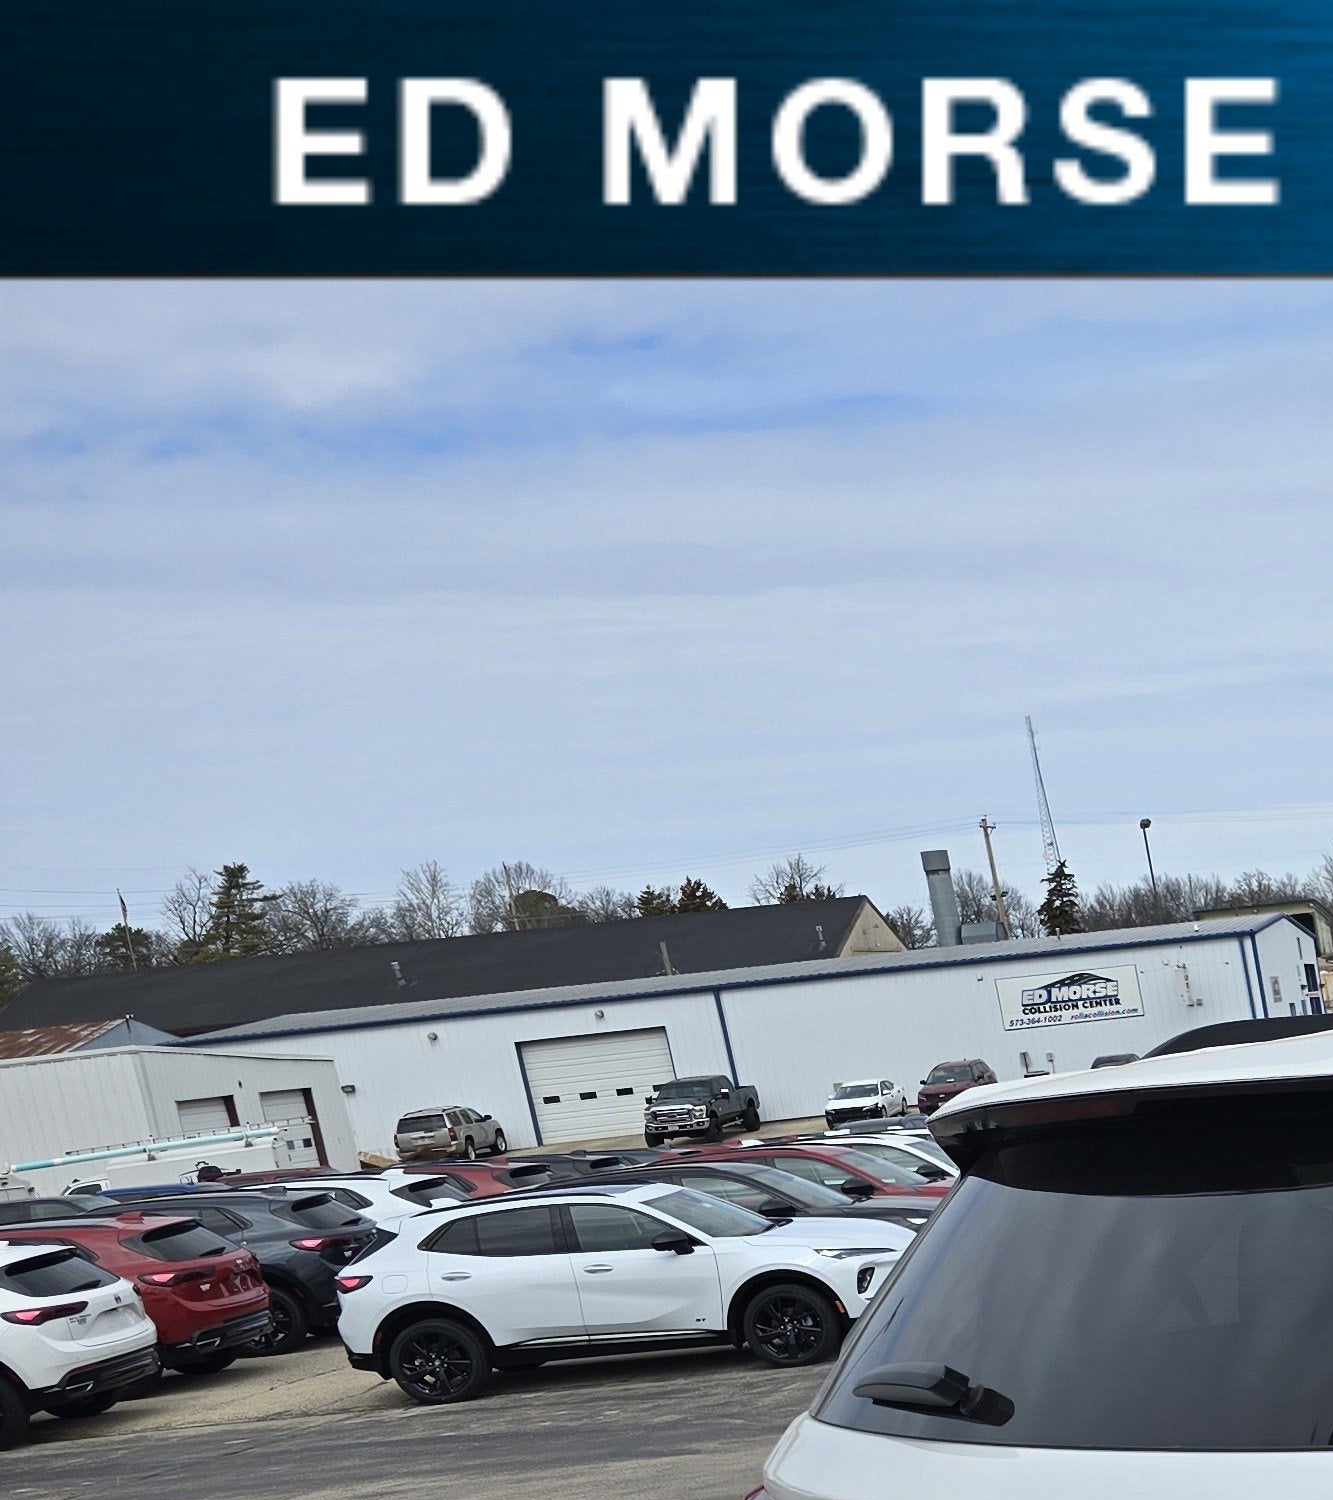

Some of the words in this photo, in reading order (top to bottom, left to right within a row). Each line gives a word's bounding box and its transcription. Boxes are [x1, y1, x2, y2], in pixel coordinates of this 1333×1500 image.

[1023, 990, 1048, 1005] ED
[1050, 981, 1119, 1002] MORSE
[1022, 1002, 1080, 1015] COLLISION
[1081, 998, 1122, 1010] CENTER
[1009, 1015, 1063, 1027] 573-364-1002
